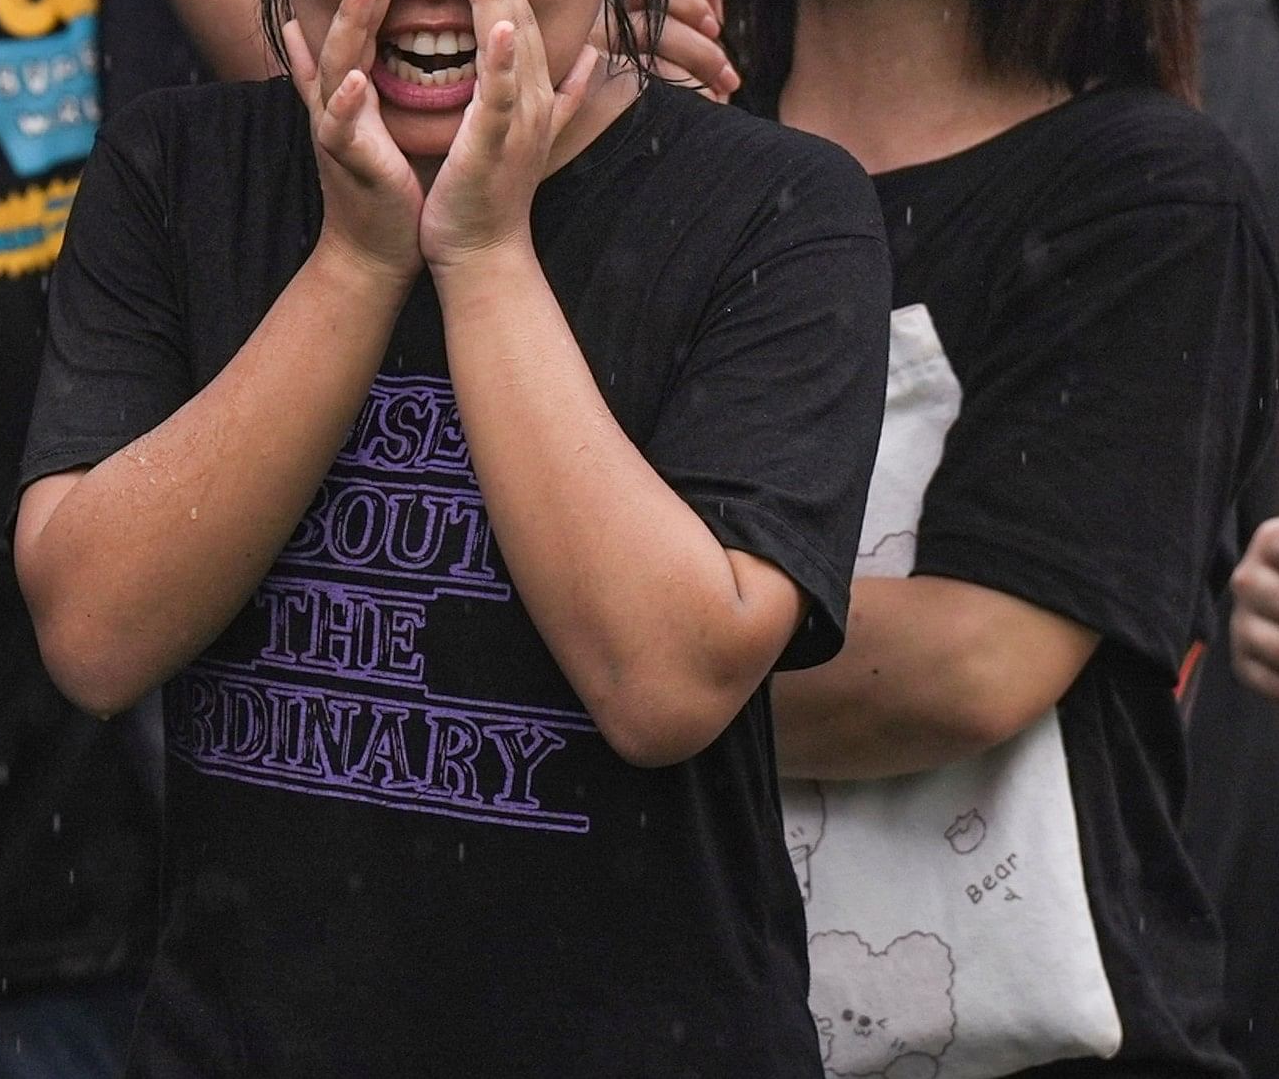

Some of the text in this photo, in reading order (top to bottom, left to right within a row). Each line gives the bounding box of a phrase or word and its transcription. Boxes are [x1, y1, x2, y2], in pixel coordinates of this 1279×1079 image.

[255, 583, 427, 679] THE
[178, 679, 567, 809] RDINARY
[965, 853, 1017, 904] Bear
